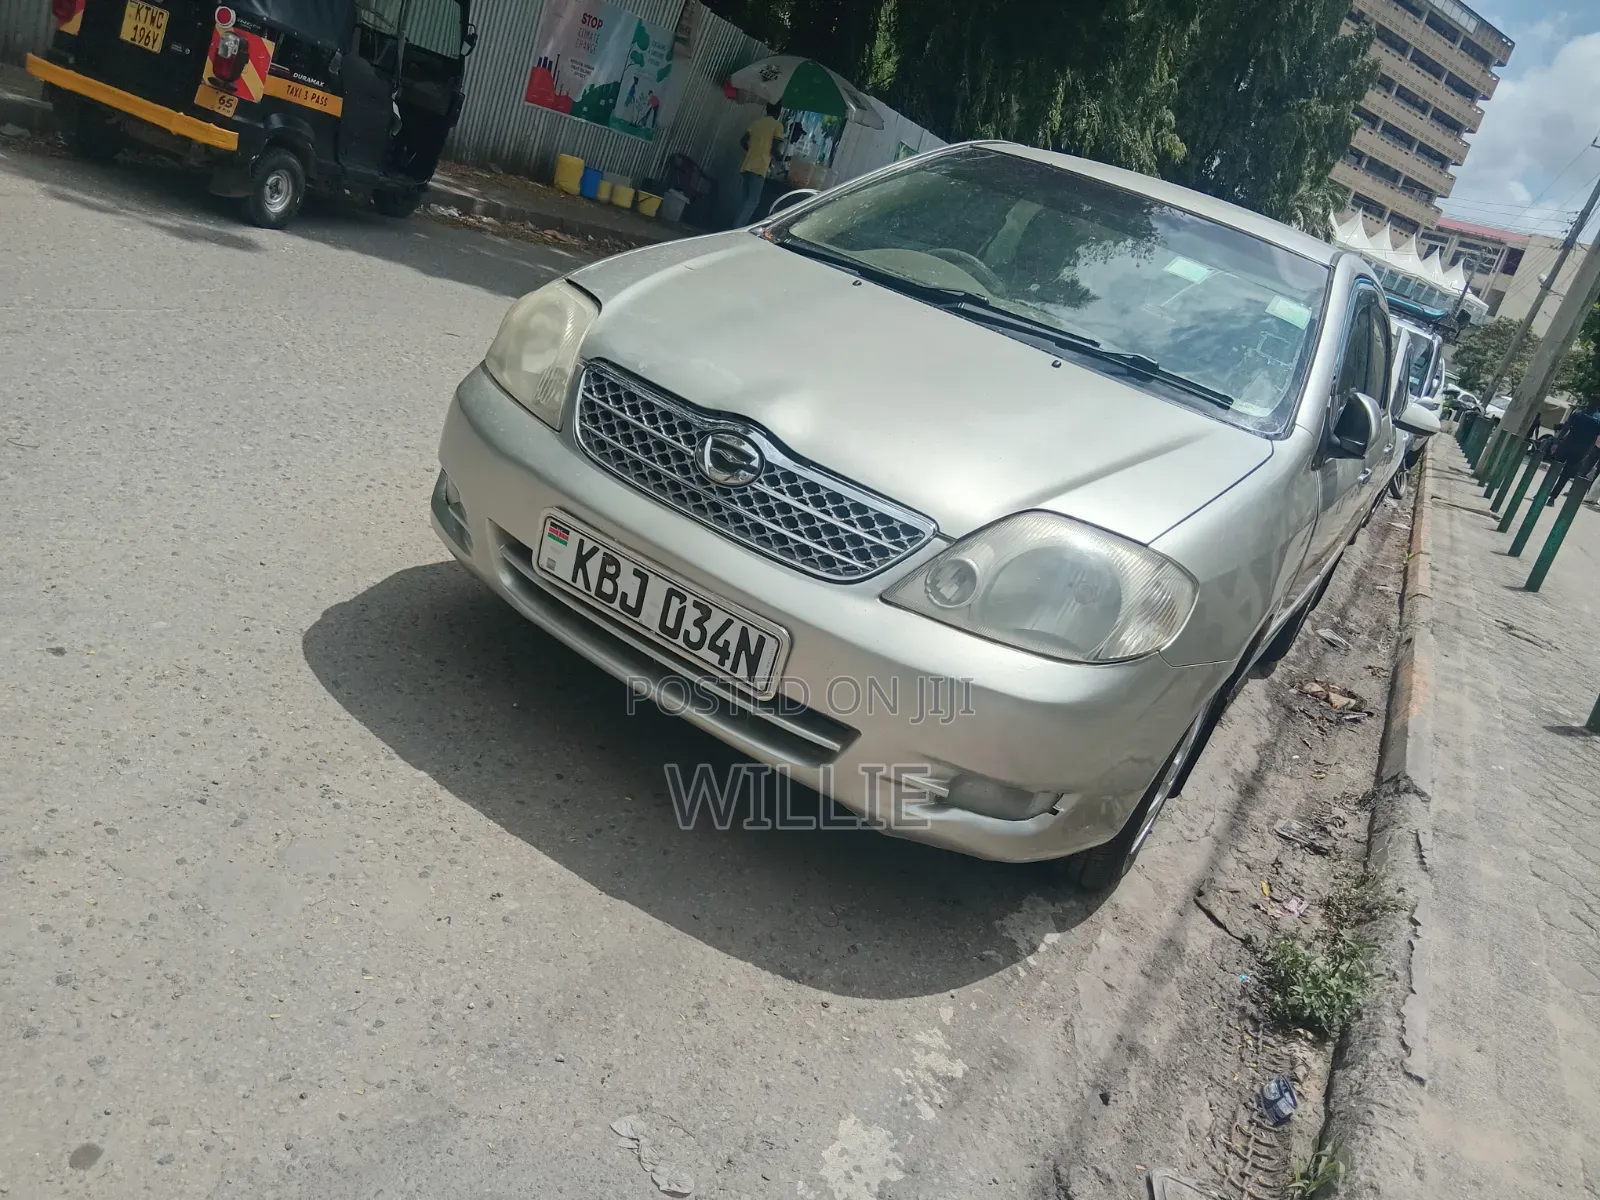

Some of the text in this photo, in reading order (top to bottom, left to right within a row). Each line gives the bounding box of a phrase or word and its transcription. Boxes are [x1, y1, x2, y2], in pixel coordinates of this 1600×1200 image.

[581, 12, 603, 30] STOP
[130, 24, 159, 49] 196Y
[577, 28, 600, 44] CLIMATE
[293, 72, 325, 88] DURAMAX
[218, 95, 234, 108] 65
[286, 84, 329, 107] TAXI 3 PASS
[571, 538, 766, 682] KBJ 034N
